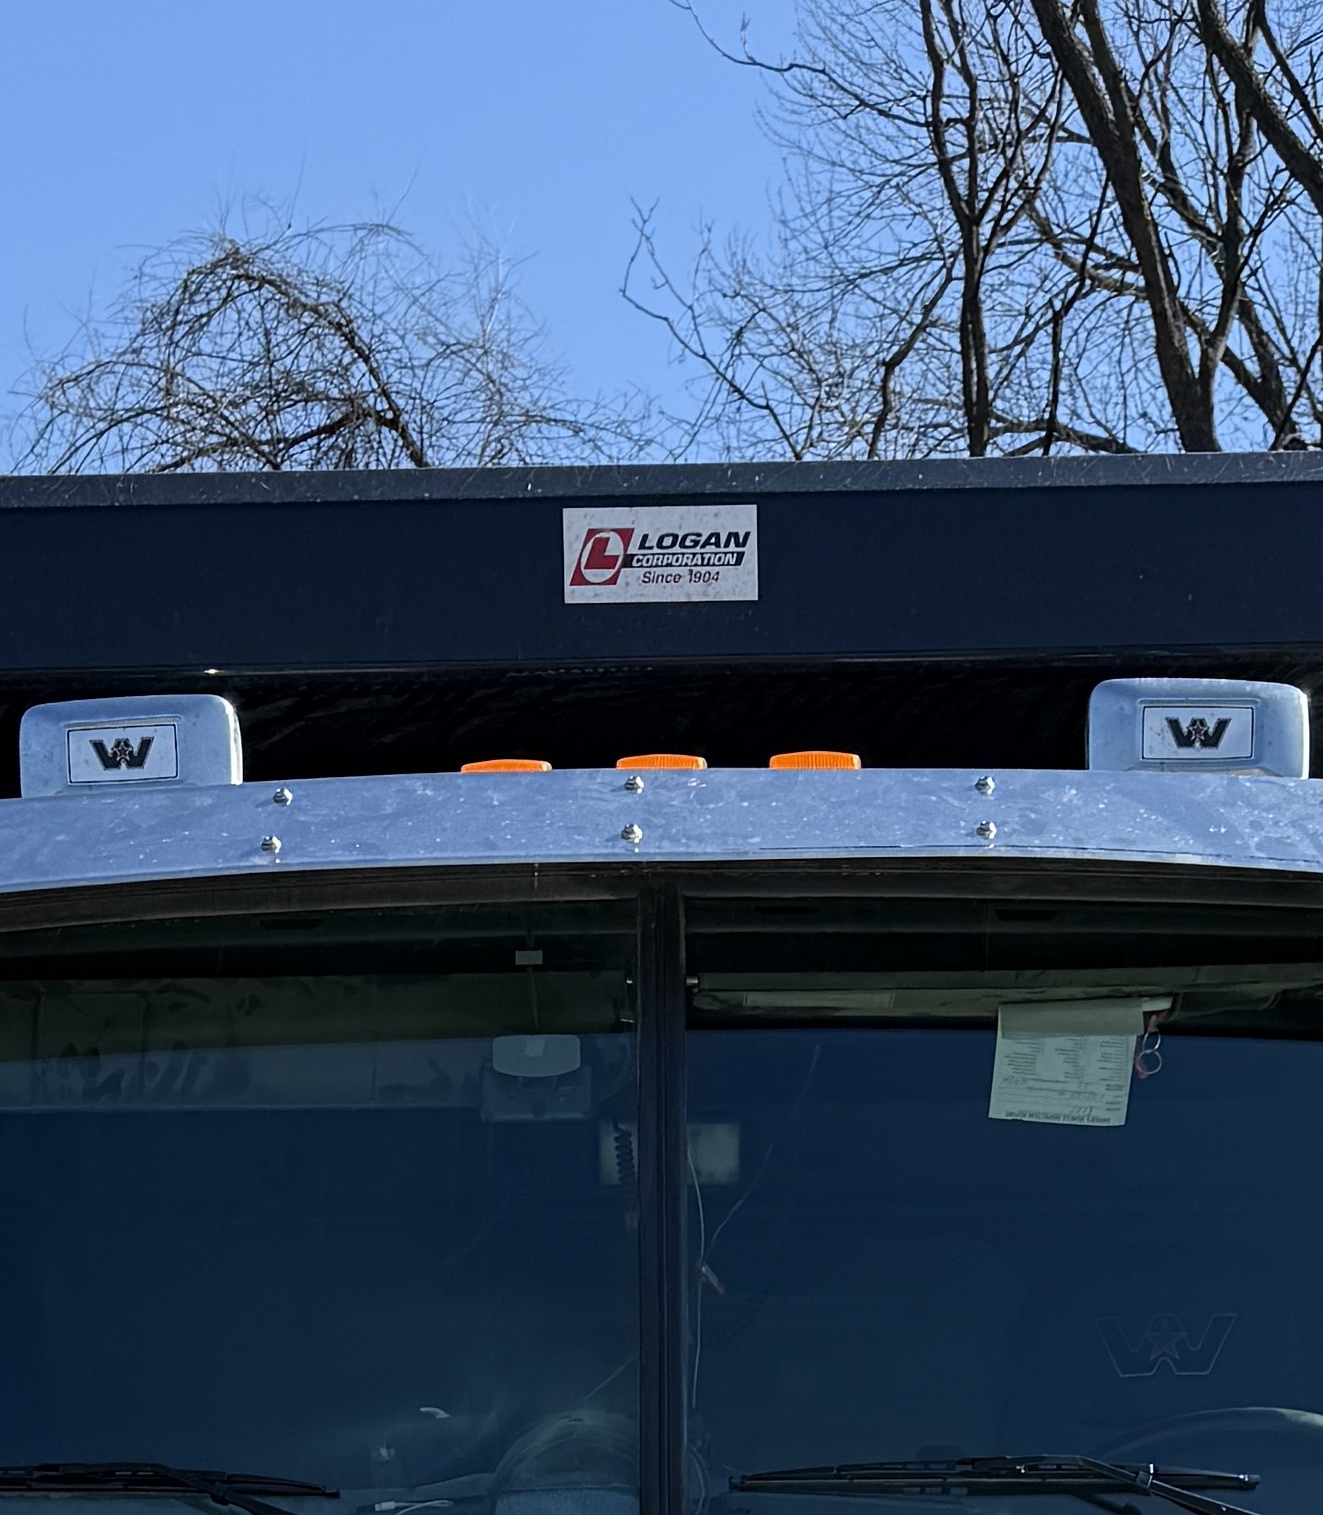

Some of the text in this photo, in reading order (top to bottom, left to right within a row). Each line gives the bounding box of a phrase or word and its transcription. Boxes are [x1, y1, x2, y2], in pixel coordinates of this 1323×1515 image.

[637, 531, 751, 550] LOGAN
[583, 536, 621, 570] L
[631, 552, 738, 567] CORPORATION
[641, 569, 720, 584] Since 1904
